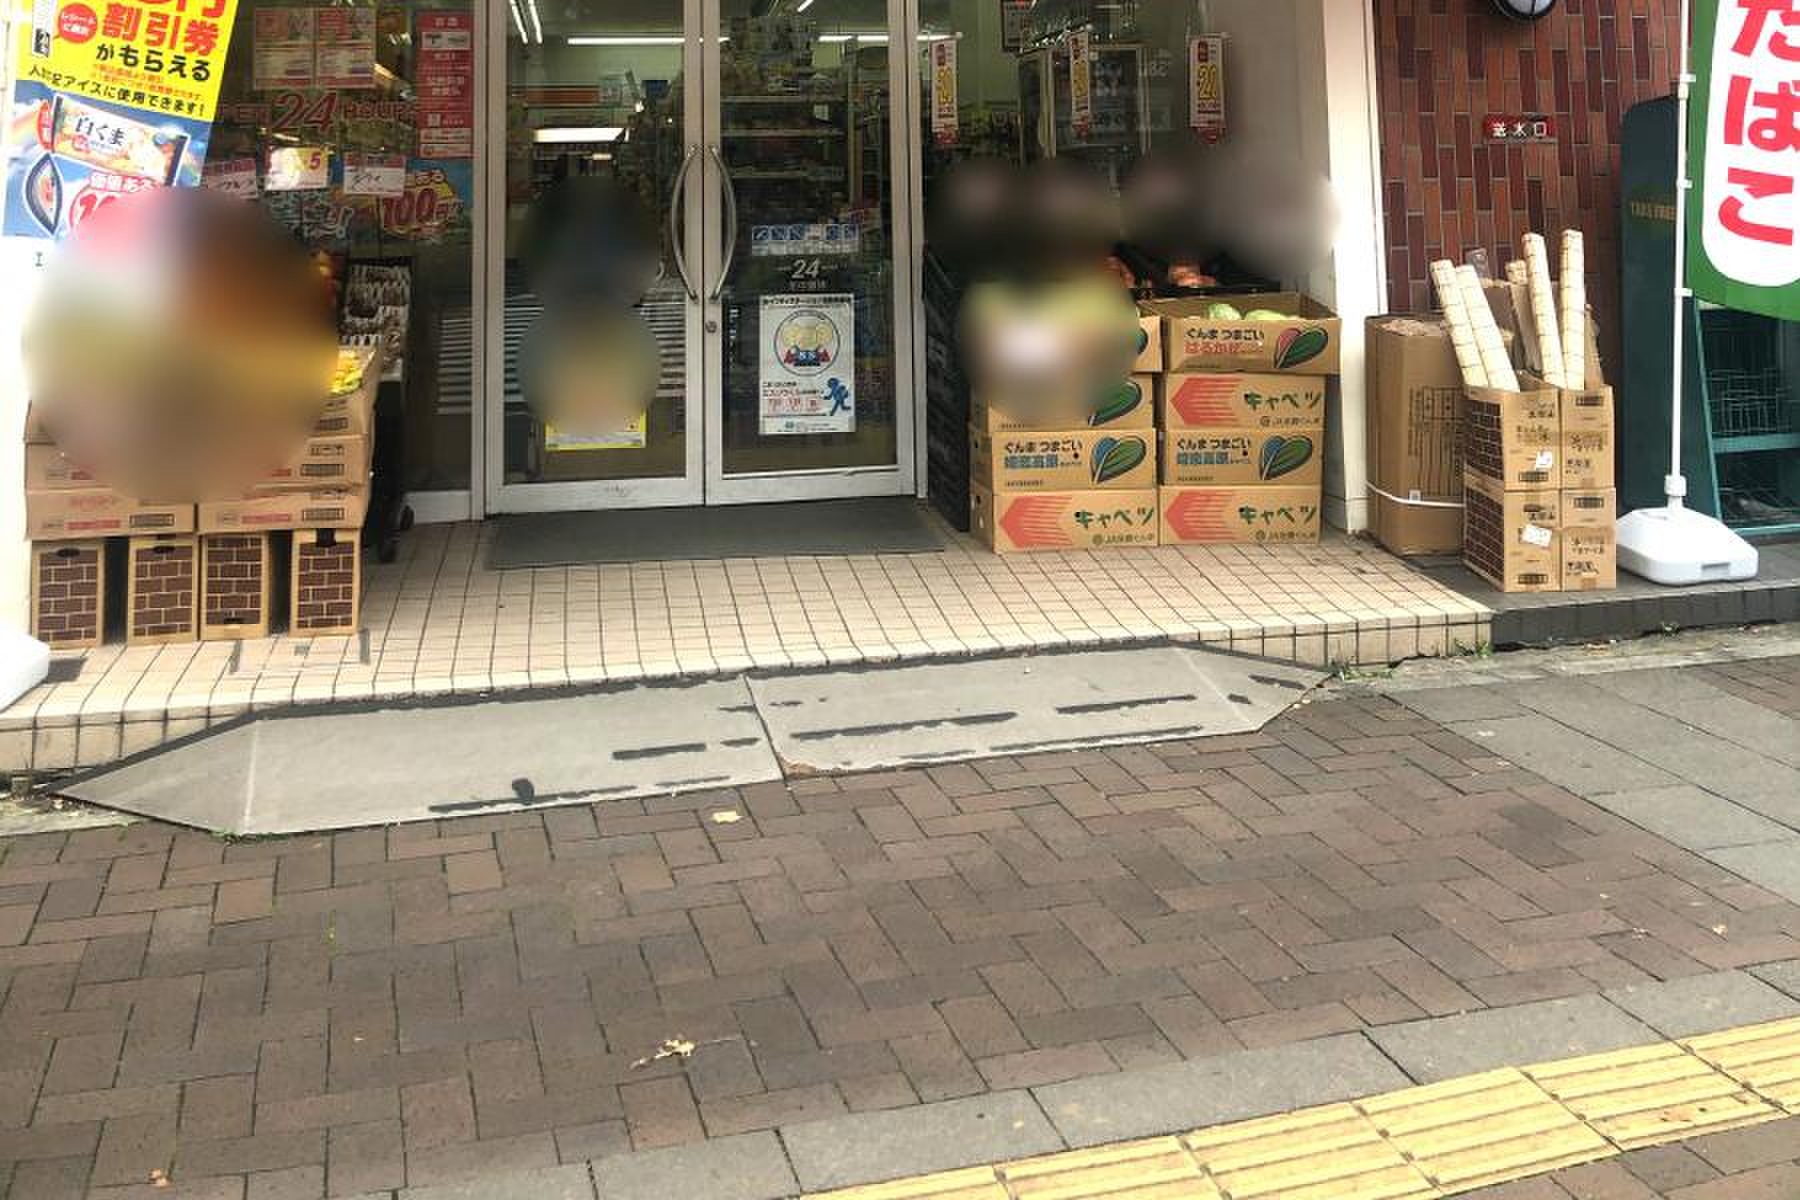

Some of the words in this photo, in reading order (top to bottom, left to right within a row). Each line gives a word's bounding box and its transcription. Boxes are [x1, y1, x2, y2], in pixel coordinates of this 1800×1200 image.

[101, 1, 222, 57] 割引券
[95, 42, 212, 83] がもらえる
[1244, 390, 1322, 412] キャベツ
[1075, 508, 1156, 528] キャベツ
[1239, 506, 1318, 526] キャベツ
